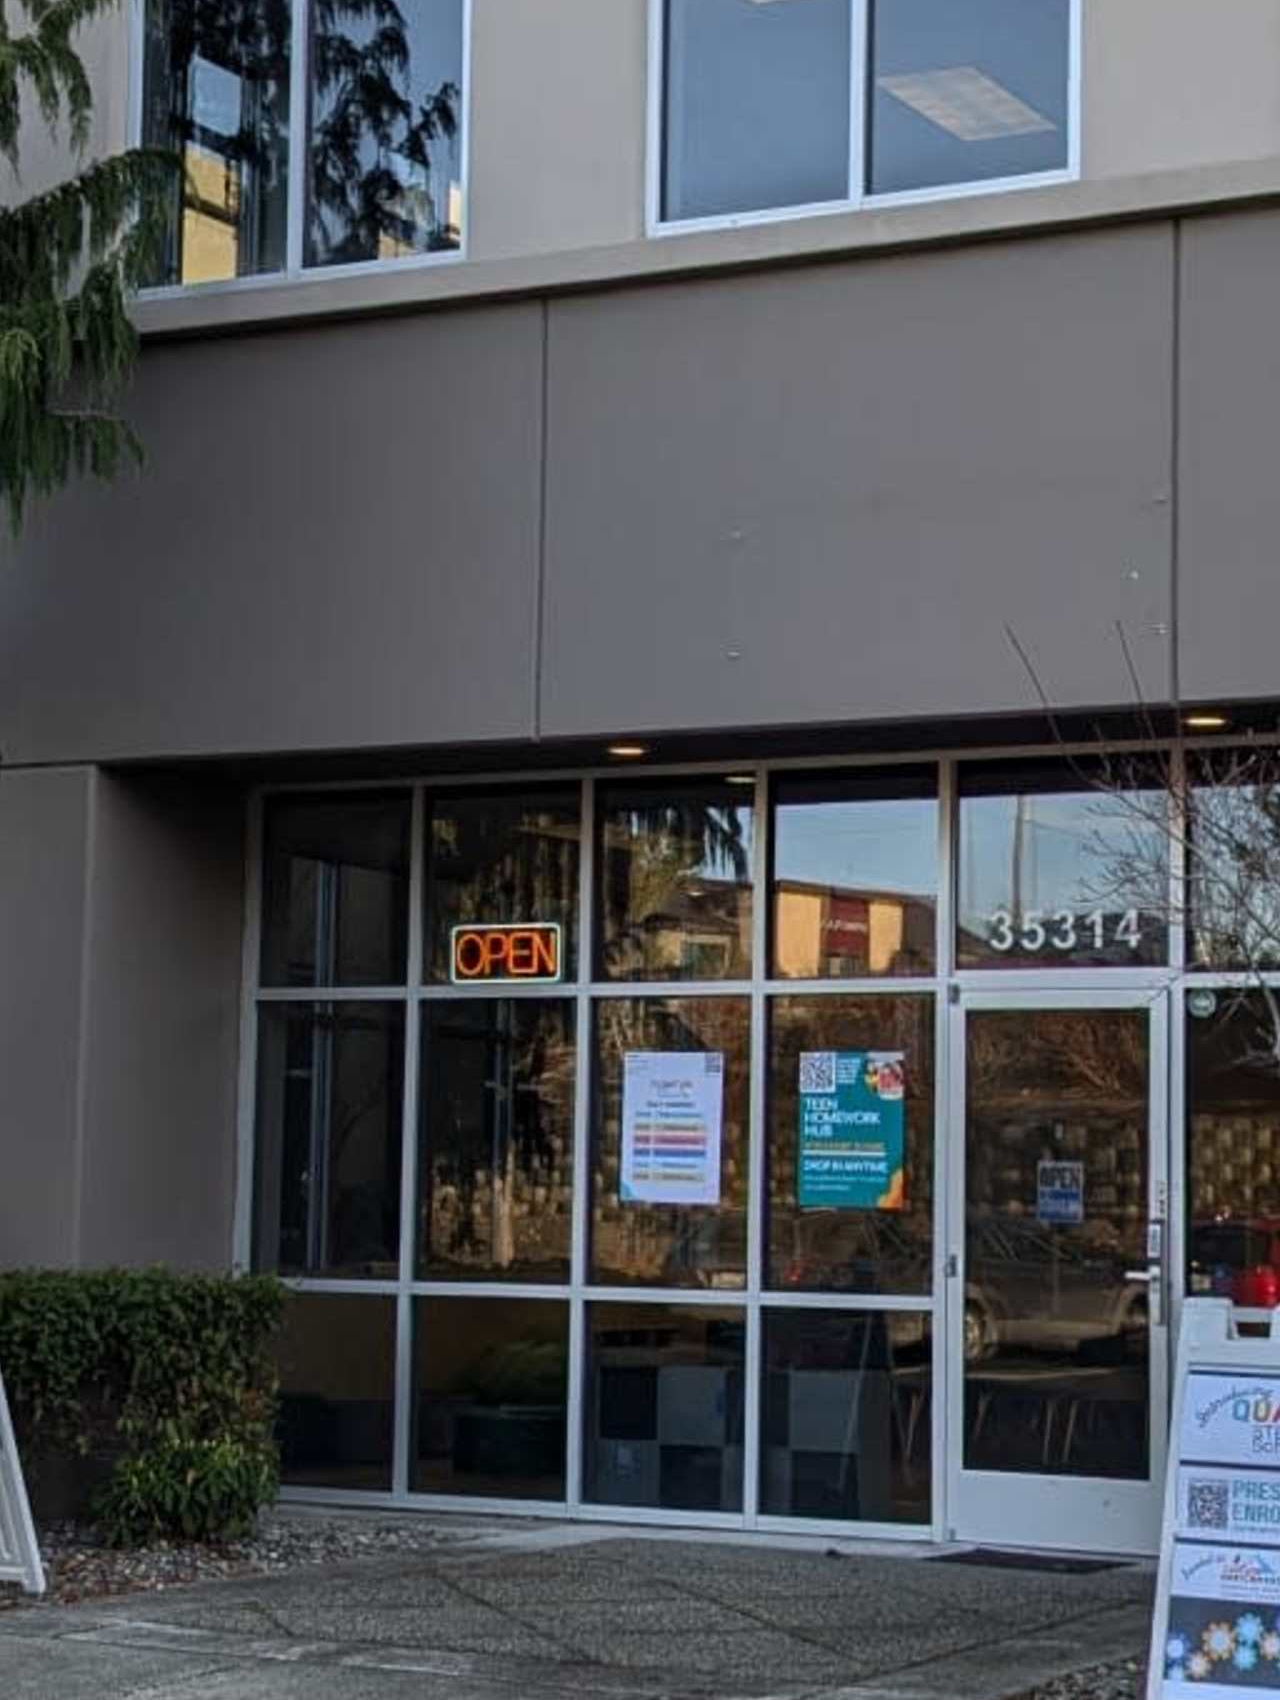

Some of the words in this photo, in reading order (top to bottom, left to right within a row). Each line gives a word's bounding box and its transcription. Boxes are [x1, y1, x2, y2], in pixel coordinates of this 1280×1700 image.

[989, 908, 1142, 951] 35314
[456, 930, 556, 976] OPEN
[806, 1098, 839, 1110] TEEN
[804, 1111, 881, 1125] HOMEWORK
[804, 1124, 833, 1137] HUB
